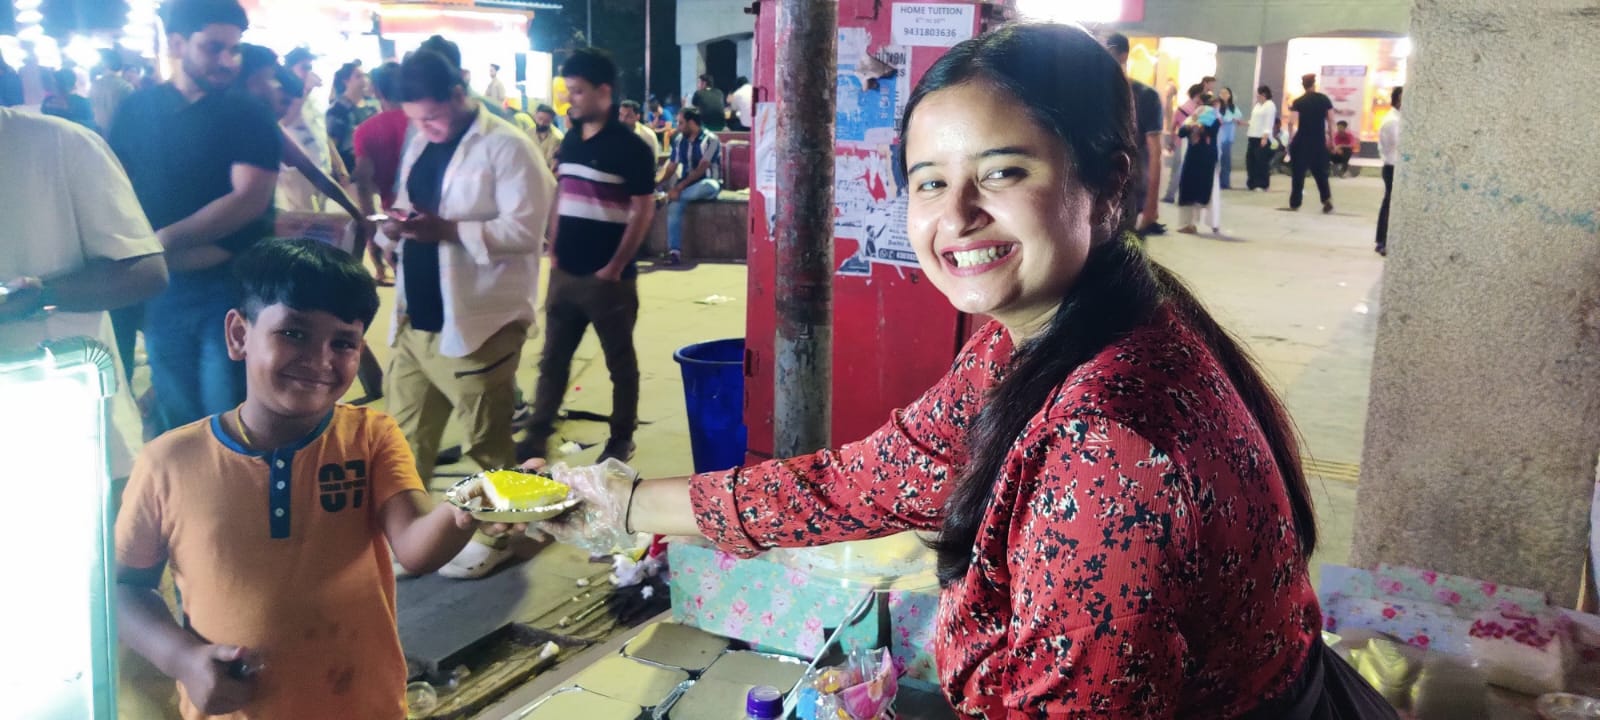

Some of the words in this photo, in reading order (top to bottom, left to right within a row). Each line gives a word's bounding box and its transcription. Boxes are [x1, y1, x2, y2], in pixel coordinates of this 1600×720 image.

[900, 6, 926, 14] HOME
[927, 6, 963, 15] TUITION
[903, 27, 957, 37] 9431803636
[318, 461, 366, 512] 07
